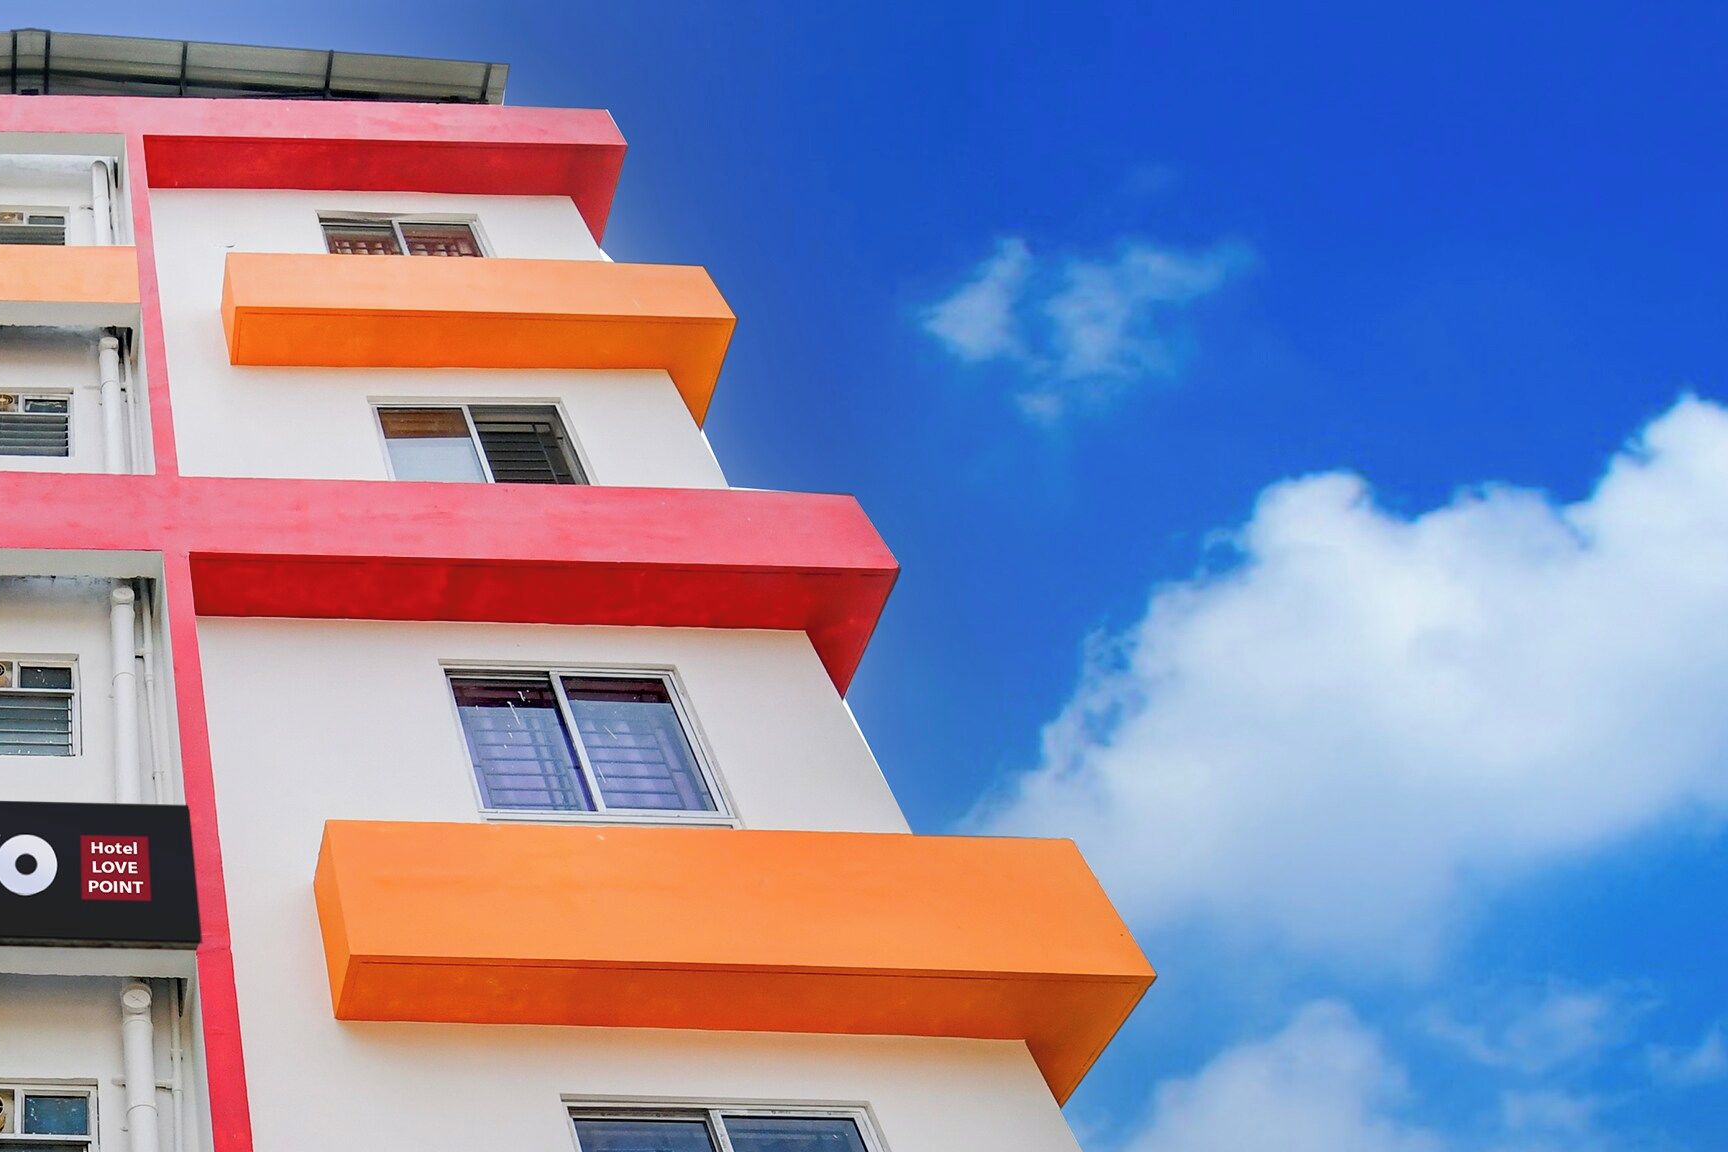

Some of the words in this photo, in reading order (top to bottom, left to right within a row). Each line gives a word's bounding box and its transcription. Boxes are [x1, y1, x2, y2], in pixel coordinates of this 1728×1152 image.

[90, 841, 138, 855] Hotel
[91, 860, 139, 874] LOVE
[88, 880, 144, 894] POINT
